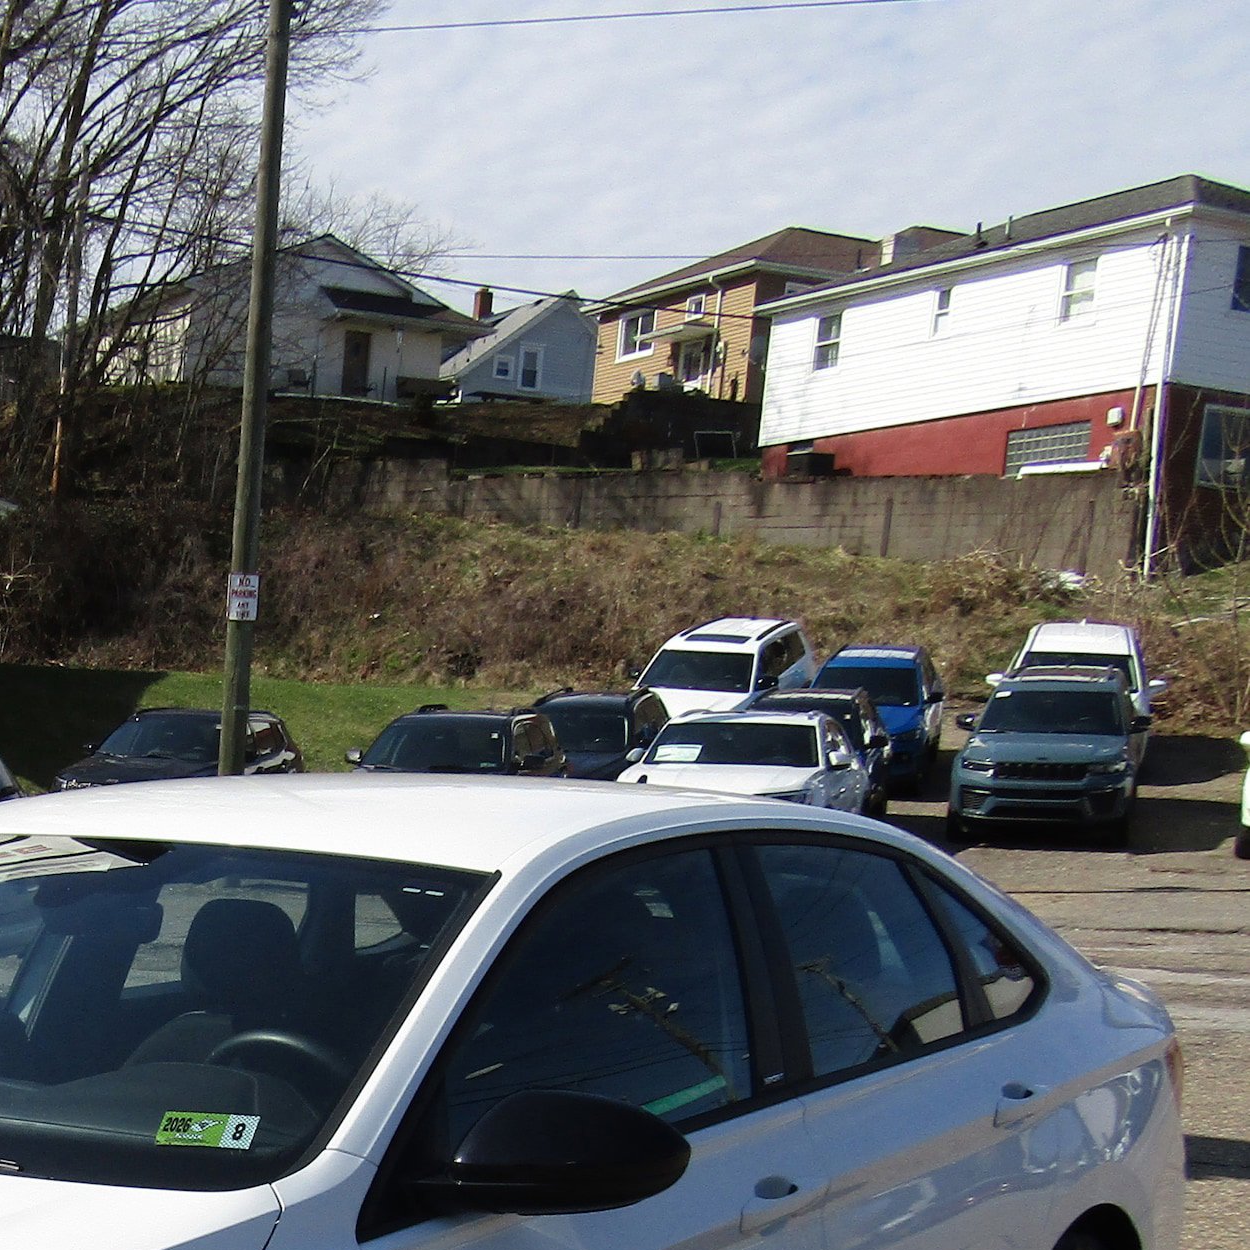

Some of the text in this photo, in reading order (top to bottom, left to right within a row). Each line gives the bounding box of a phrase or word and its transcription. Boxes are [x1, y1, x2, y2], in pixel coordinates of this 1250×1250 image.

[237, 577, 251, 588] NO
[162, 1117, 246, 1141] 2026 8
